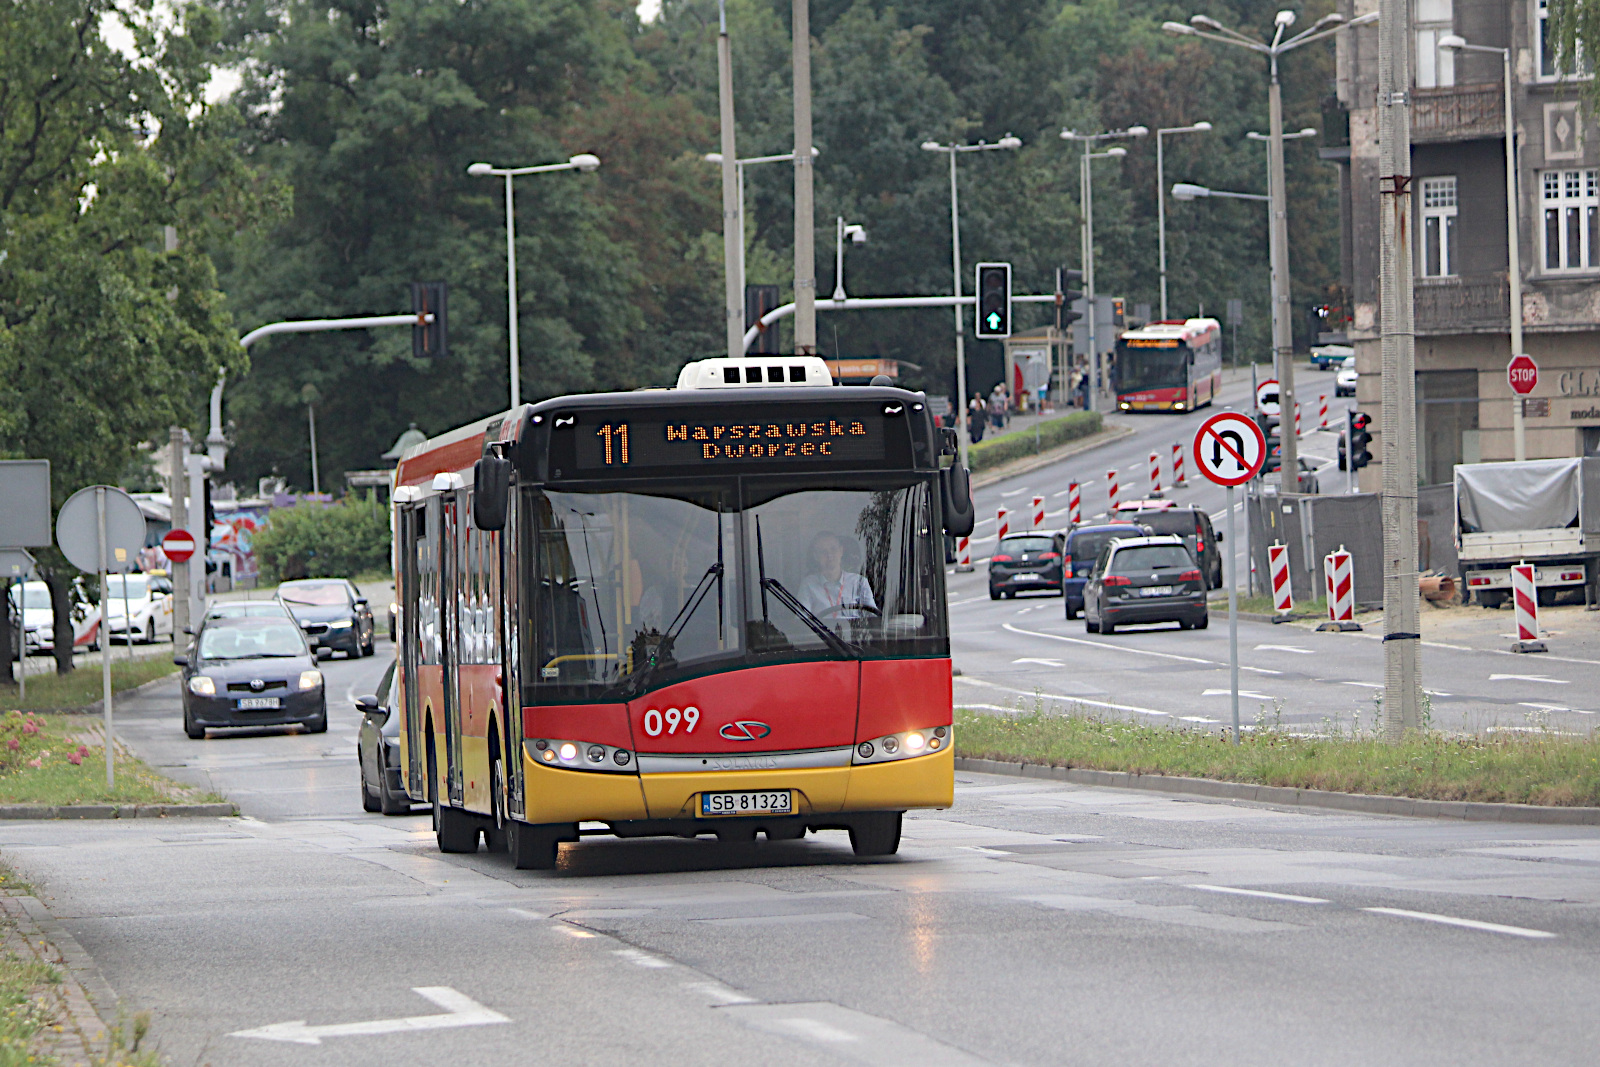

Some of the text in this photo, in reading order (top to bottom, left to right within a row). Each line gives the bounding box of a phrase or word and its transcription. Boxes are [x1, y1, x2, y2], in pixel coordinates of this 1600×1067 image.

[1511, 368, 1535, 382] STOP
[597, 420, 866, 464] 11 Warszawska
[703, 442, 832, 459] Dworzec
[644, 706, 700, 737] 099
[712, 756, 777, 770] SOLARIS
[712, 793, 788, 810] SB 81323
